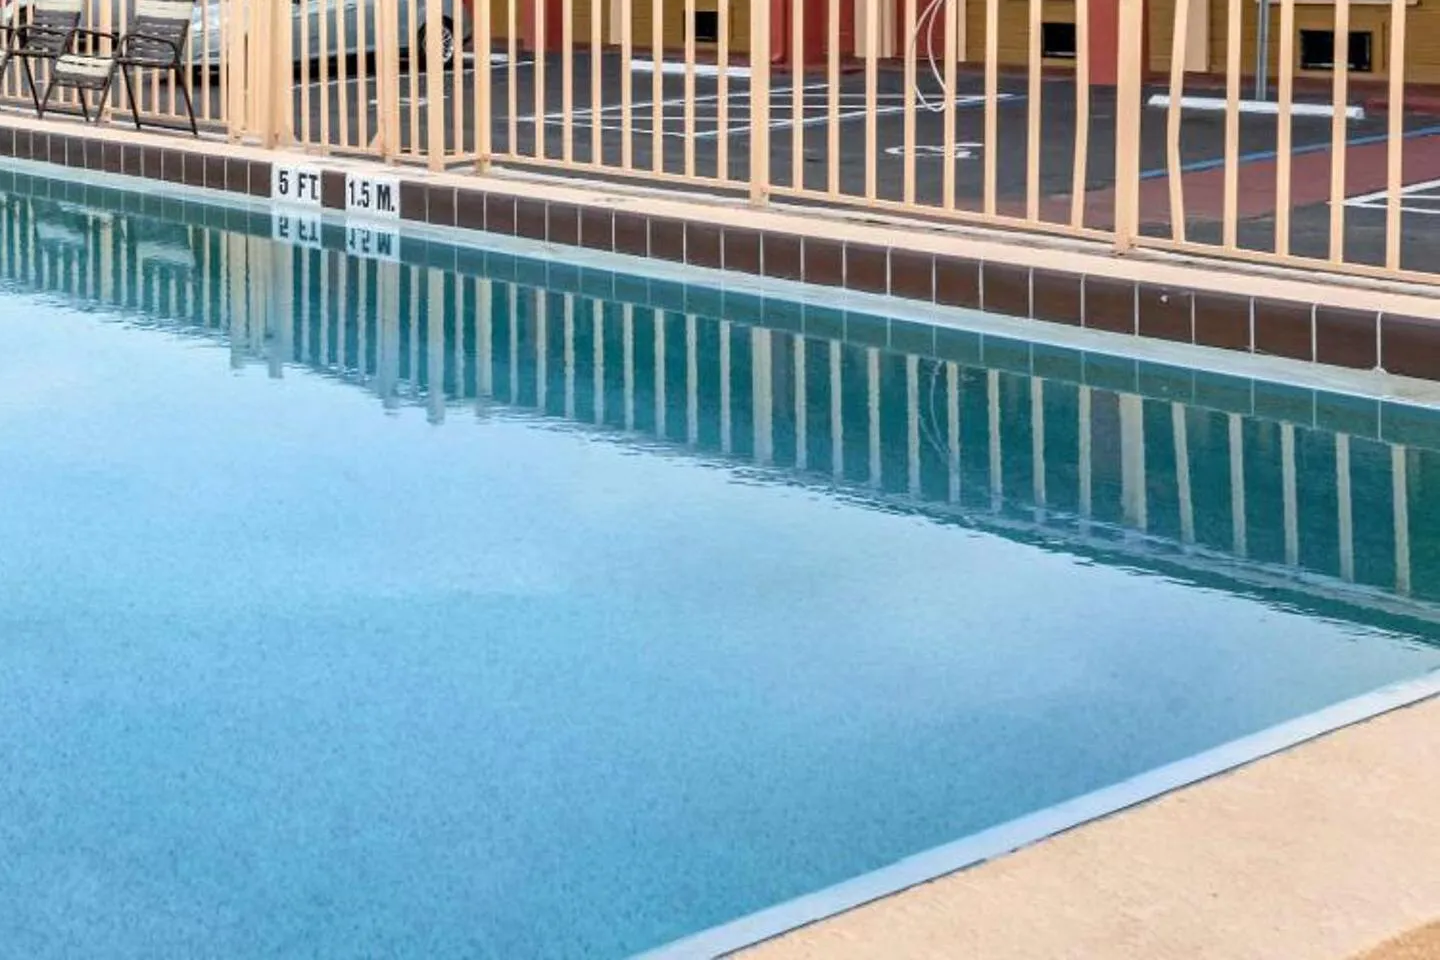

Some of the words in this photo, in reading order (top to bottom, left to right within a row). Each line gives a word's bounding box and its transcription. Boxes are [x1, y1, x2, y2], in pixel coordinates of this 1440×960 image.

[279, 170, 289, 195] 5
[298, 172, 319, 200] FT
[349, 180, 370, 208] 1.5
